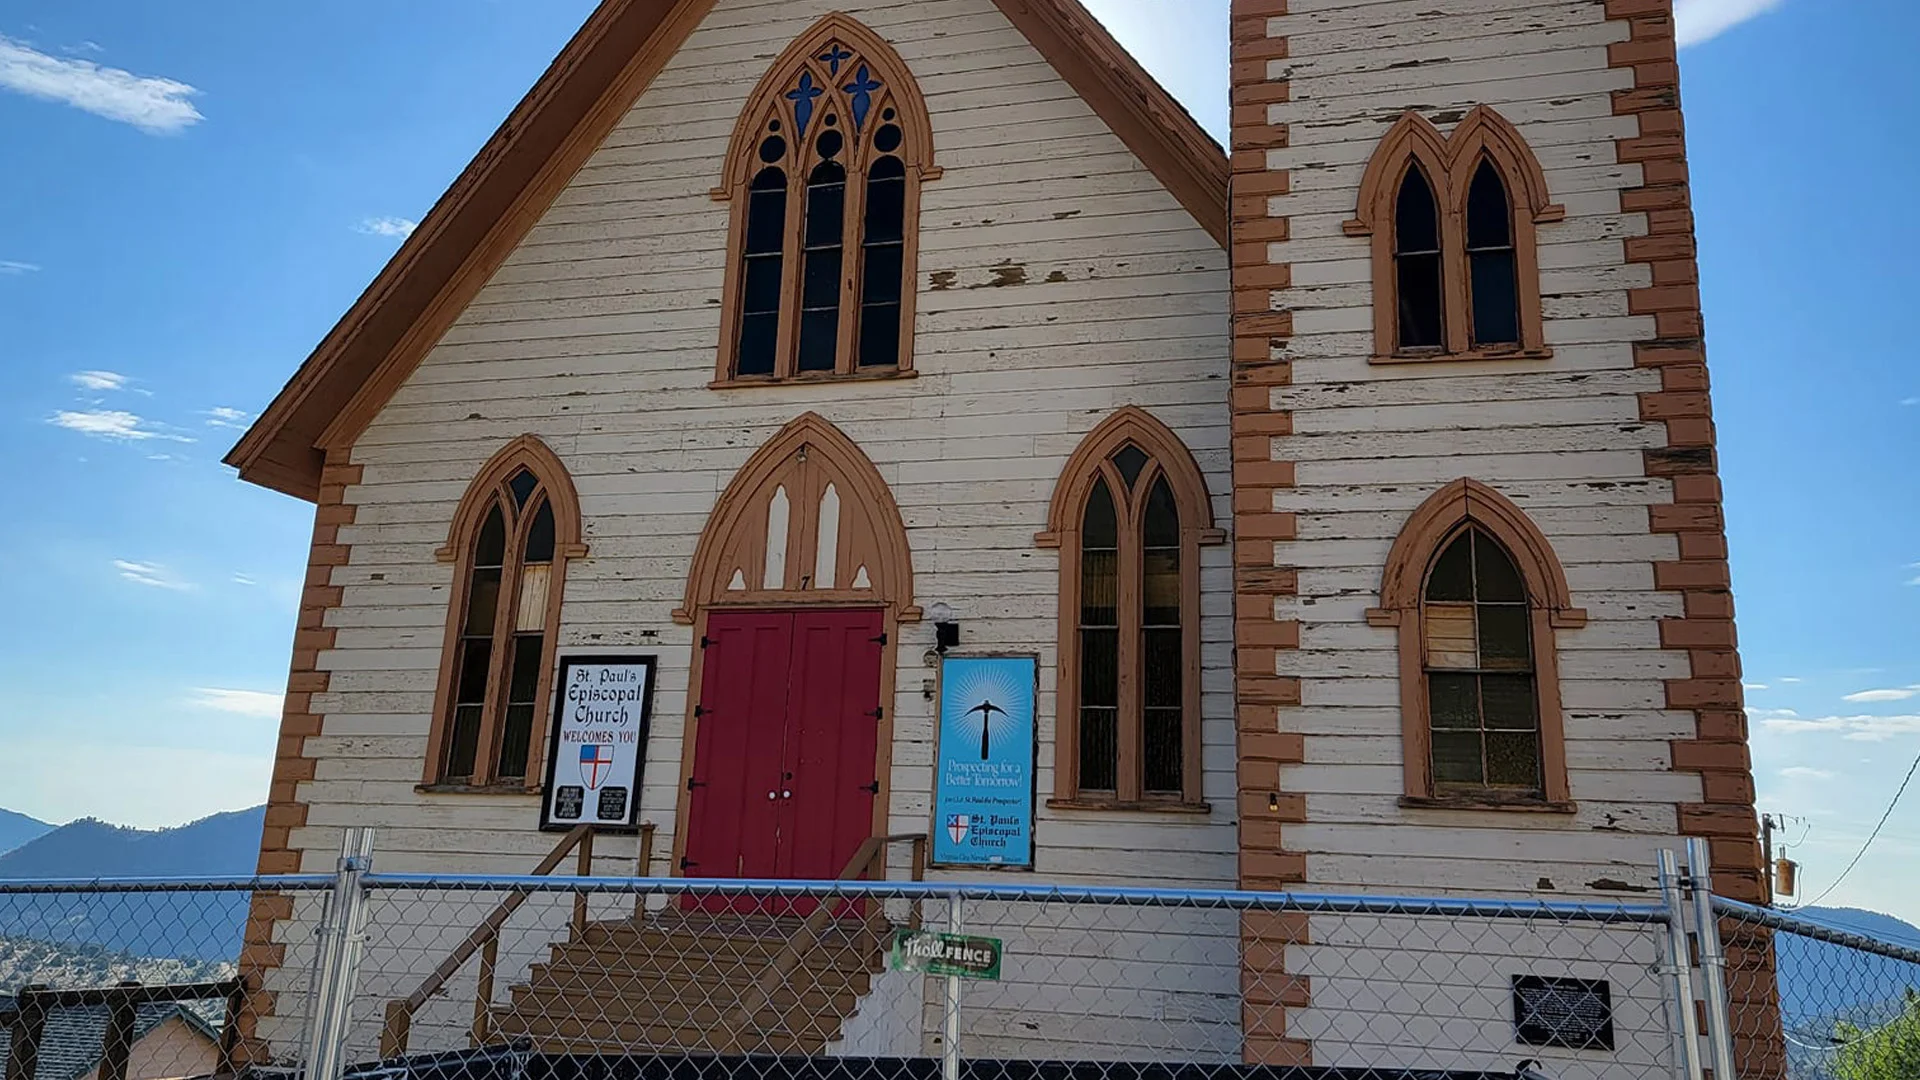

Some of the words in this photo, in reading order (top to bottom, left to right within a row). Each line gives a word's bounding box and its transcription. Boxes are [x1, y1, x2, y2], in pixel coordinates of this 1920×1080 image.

[576, 668, 592, 683] St.
[600, 668, 637, 686] Paul's
[568, 684, 641, 705] Episcopal
[575, 705, 629, 727] Church
[563, 730, 614, 743] WELCOMES
[618, 730, 637, 743] YOU
[948, 759, 999, 777] Prospecting
[1000, 760, 1013, 773] for
[1014, 764, 1021, 773] a
[946, 772, 971, 786] Better
[971, 814, 986, 825] St.
[970, 825, 1021, 838] Episcopal
[970, 837, 1007, 848] Church
[945, 946, 992, 964] FENCE
